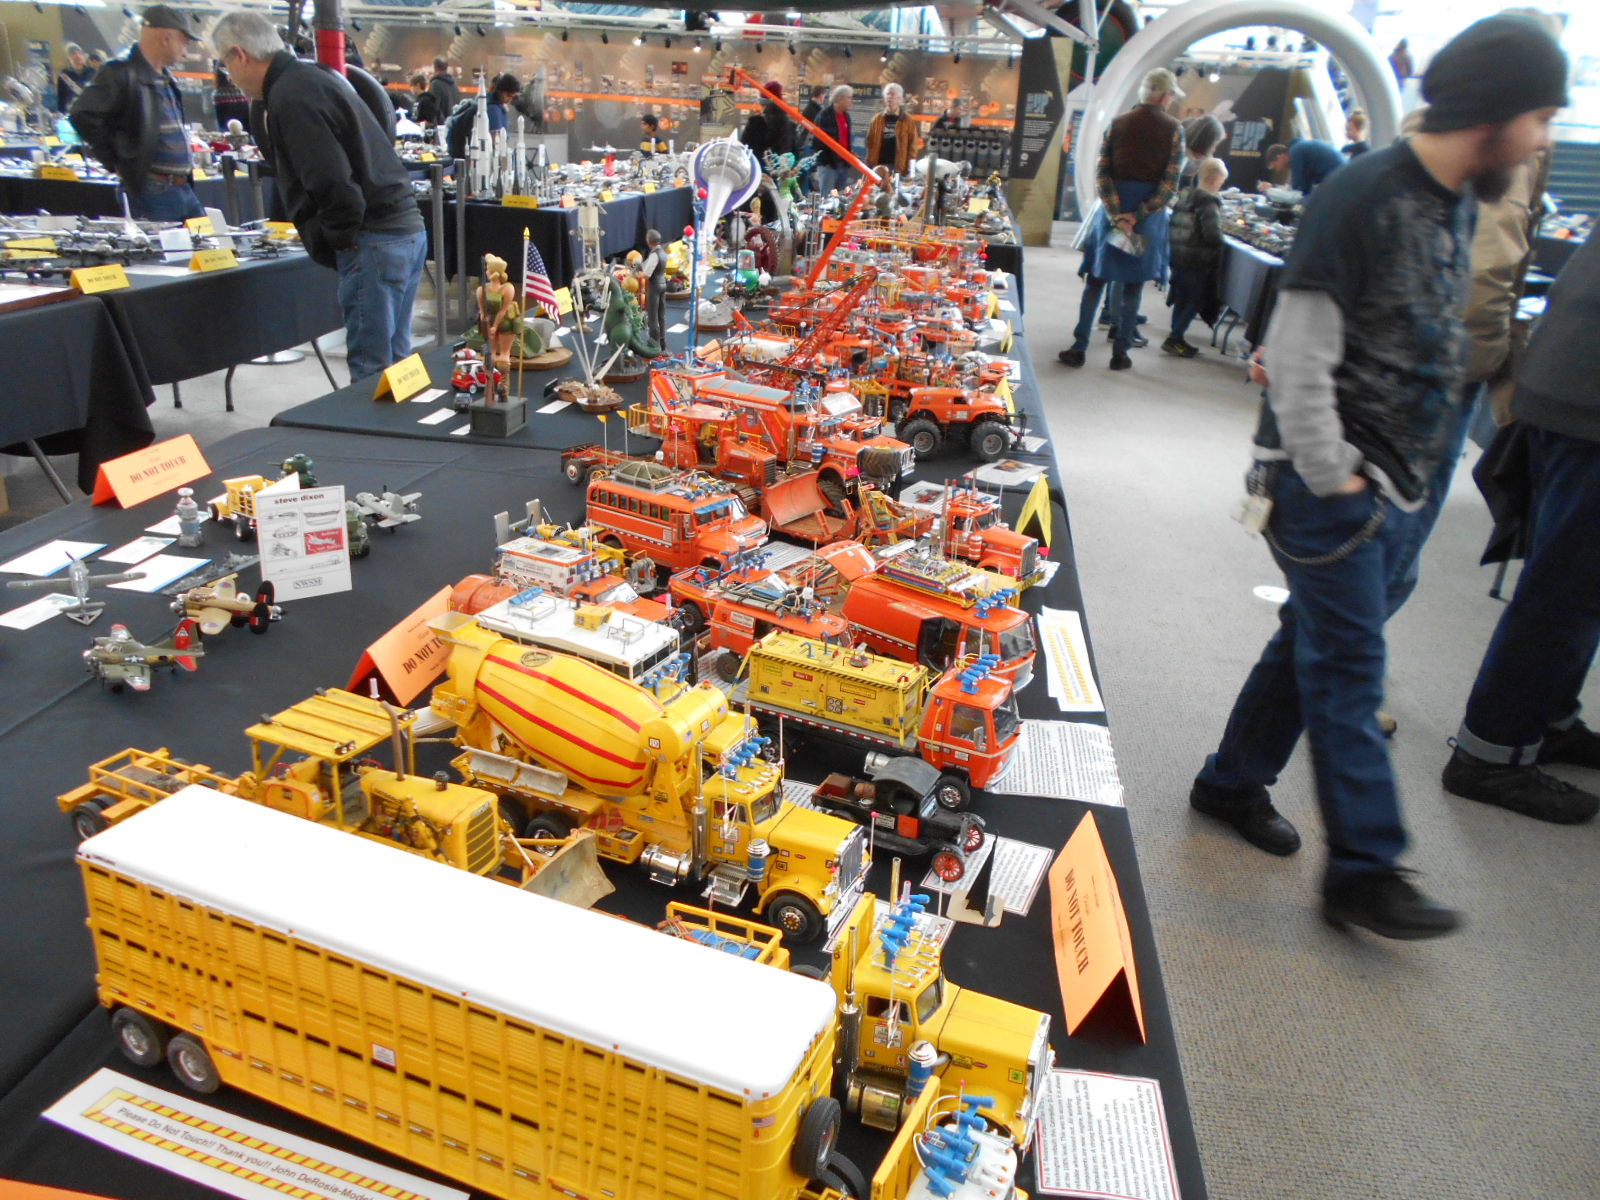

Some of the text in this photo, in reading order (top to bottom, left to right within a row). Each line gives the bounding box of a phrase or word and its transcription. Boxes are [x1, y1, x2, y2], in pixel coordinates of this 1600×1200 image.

[129, 472, 142, 484] DO
[142, 466, 160, 478] NOT
[160, 456, 186, 472] TOUCH
[274, 494, 324, 504] steve dixon
[402, 657, 418, 674] DO
[414, 642, 434, 662] NOT
[1064, 868, 1089, 976] DO NOT TOUCH
[118, 1107, 146, 1124] Please
[148, 1118, 161, 1130] Do
[162, 1124, 182, 1136] Not
[181, 1130, 216, 1148] Touch!!
[216, 1143, 244, 1160] Thank
[244, 1155, 272, 1170] you!!
[272, 1164, 296, 1178] John
